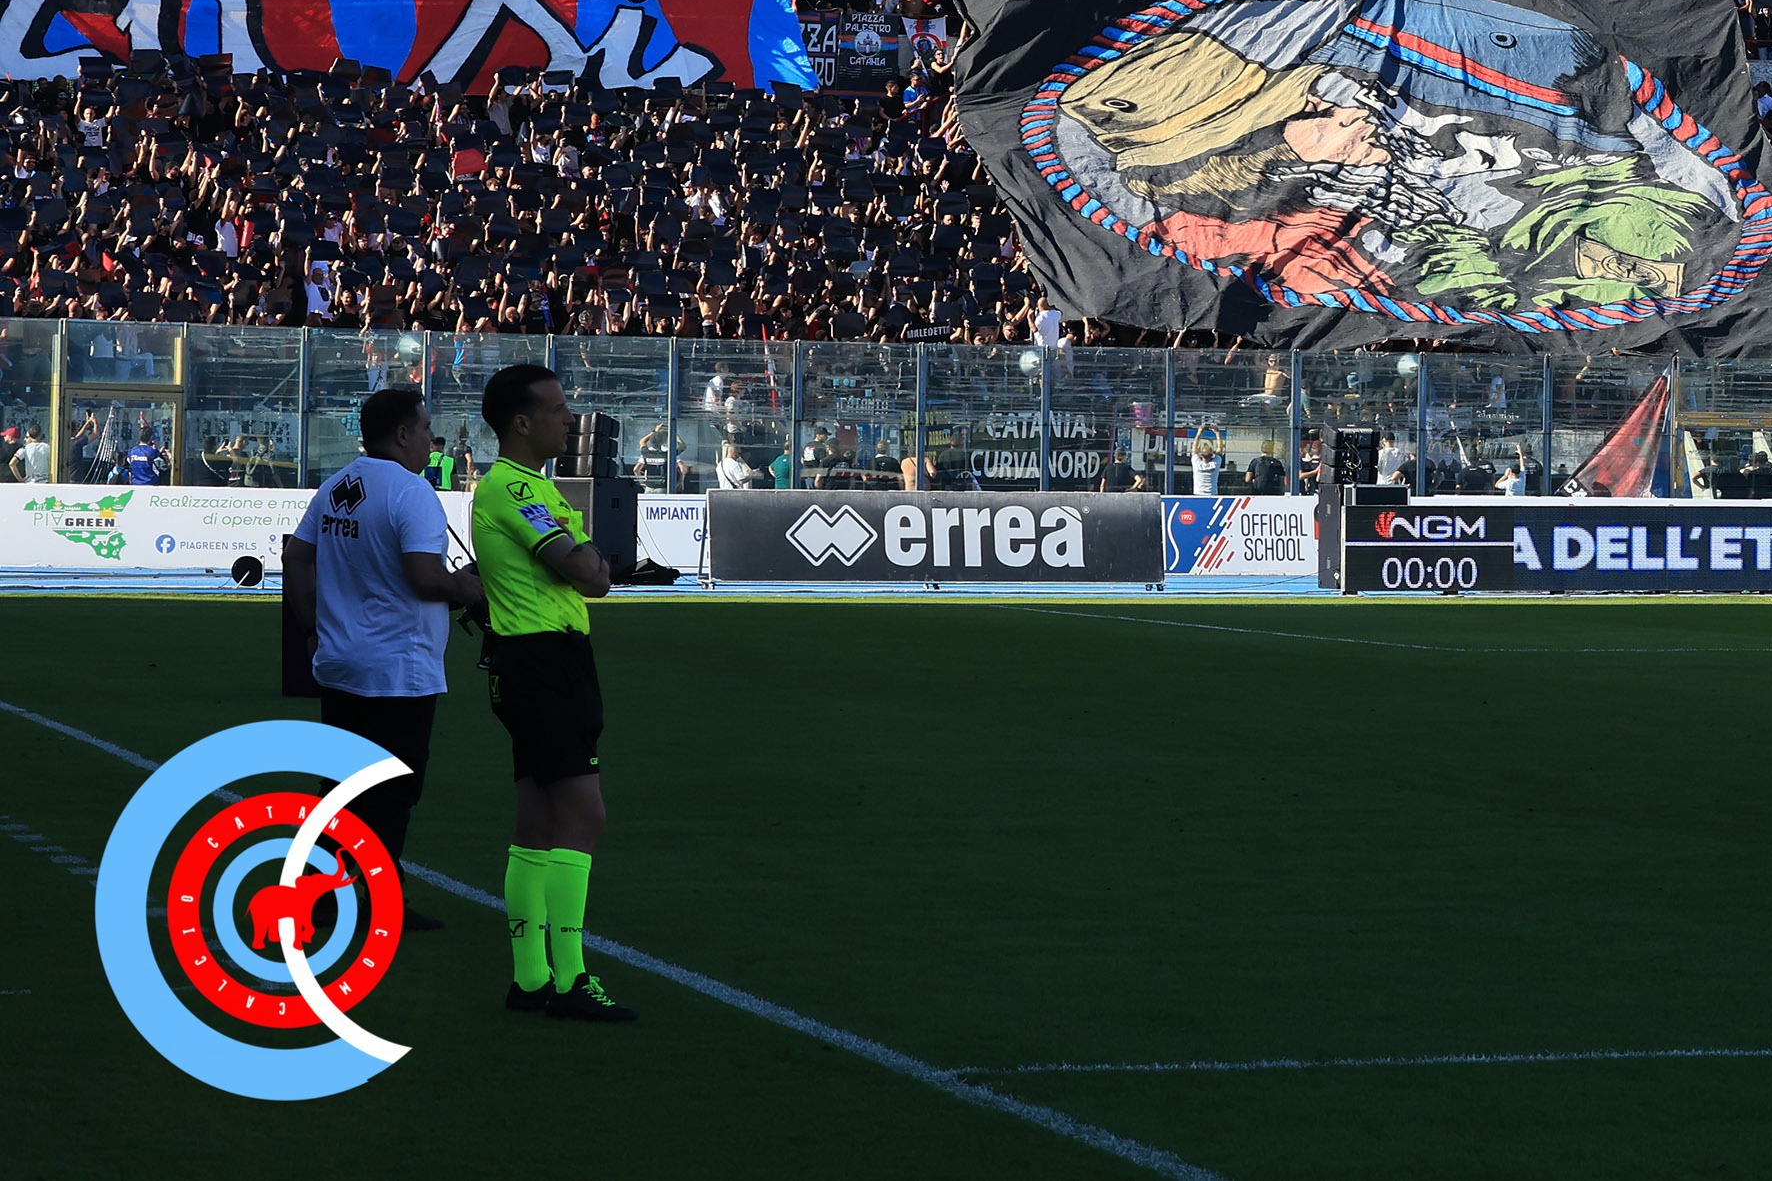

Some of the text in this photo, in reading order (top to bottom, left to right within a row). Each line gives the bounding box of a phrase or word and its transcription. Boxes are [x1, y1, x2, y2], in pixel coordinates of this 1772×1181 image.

[851, 13, 886, 24] PIAZZA
[845, 23, 892, 33] PALESTRO
[849, 56, 886, 67] CATANIA
[906, 325, 951, 339] MALEDETTA
[149, 495, 264, 510] Realizzazione
[268, 499, 279, 510] e
[203, 512, 217, 525] di
[225, 515, 273, 528] opere
[276, 512, 291, 526] in
[646, 506, 699, 521] IMPIANTI
[321, 514, 360, 539] errea
[1240, 513, 1308, 537] OFFICIAL
[1388, 513, 1487, 540] NGM
[883, 505, 1085, 569] errea
[180, 541, 257, 551] PIAGREEN SRLS
[1243, 537, 1306, 562] SCHOOL
[1380, 556, 1479, 590] 00:00
